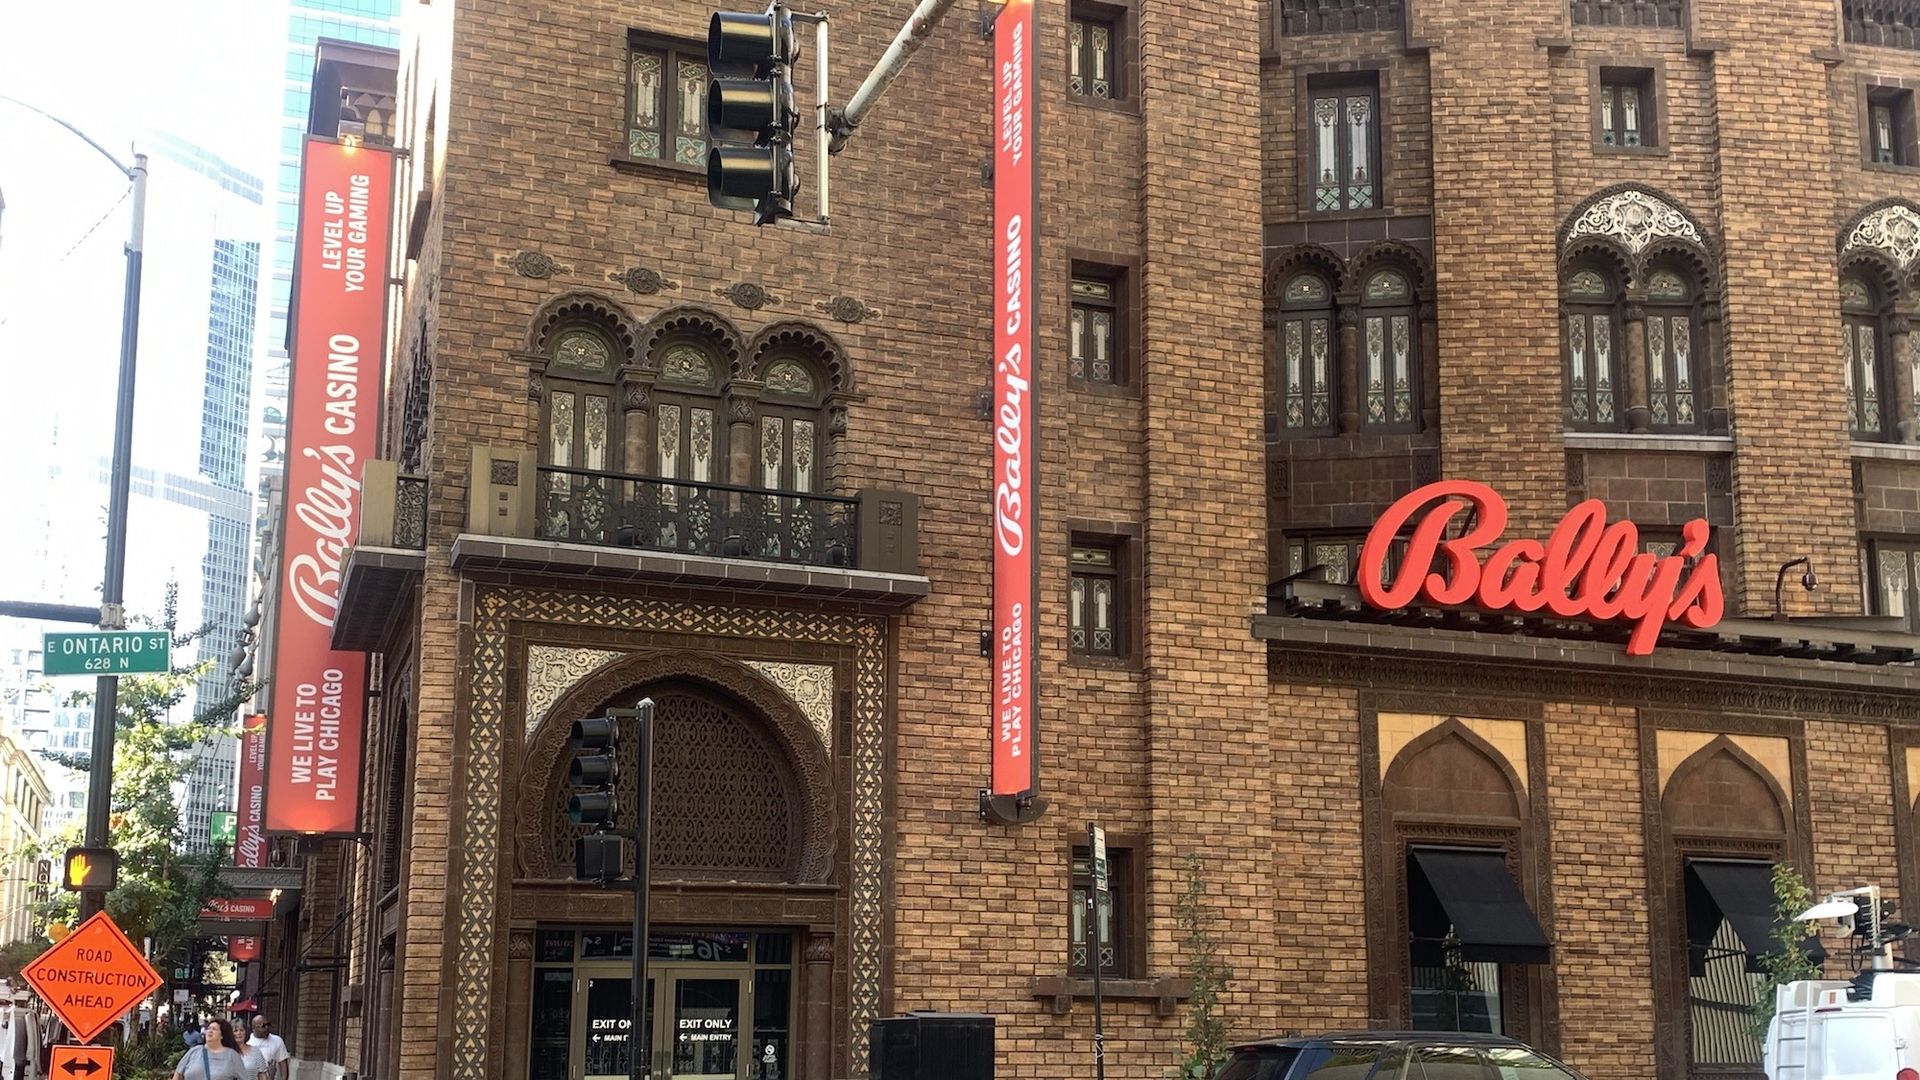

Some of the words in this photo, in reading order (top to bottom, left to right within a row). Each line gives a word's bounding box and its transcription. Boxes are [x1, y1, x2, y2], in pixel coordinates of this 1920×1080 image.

[1002, 60, 1013, 87] UP
[1012, 21, 1022, 104] GAMING
[1002, 90, 1013, 152] LEVEL
[1012, 108, 1022, 166] YOUR
[325, 191, 344, 213] UP
[348, 174, 370, 243] GAMING
[322, 219, 343, 270] LEVEL
[345, 247, 365, 292] YOUR
[1007, 214, 1022, 336] CASINO
[324, 333, 360, 435] CASINO
[996, 342, 1029, 557] Bally's
[1358, 479, 1724, 656] Bally's
[48, 641, 56, 653] E
[62, 636, 142, 655] ONTARIO
[149, 638, 165, 650] ST
[1002, 626, 1011, 657] TO
[1012, 602, 1023, 699] CHICAGO
[84, 657, 111, 670] 628
[120, 657, 129, 669] N
[1002, 660, 1011, 707] LIVE
[296, 683, 317, 707] TO
[318, 668, 343, 751] CHICAGO
[293, 711, 315, 751] LIVE
[1002, 712, 1011, 742] WE
[1011, 707, 1022, 758] PLAY
[291, 755, 312, 783] WE
[315, 755, 338, 801] PLAY
[249, 785, 263, 822] CASINO
[238, 825, 265, 868] ally's
[230, 905, 256, 913] CASINO
[76, 948, 112, 963] ROAD
[36, 967, 147, 988] CONSTRUCTION
[63, 993, 114, 1009] AHEAD
[592, 1019, 616, 1029] EXIT
[604, 1034, 623, 1042] MAIN
[679, 1019, 702, 1029] EXIT
[704, 1019, 732, 1029] ONLY
